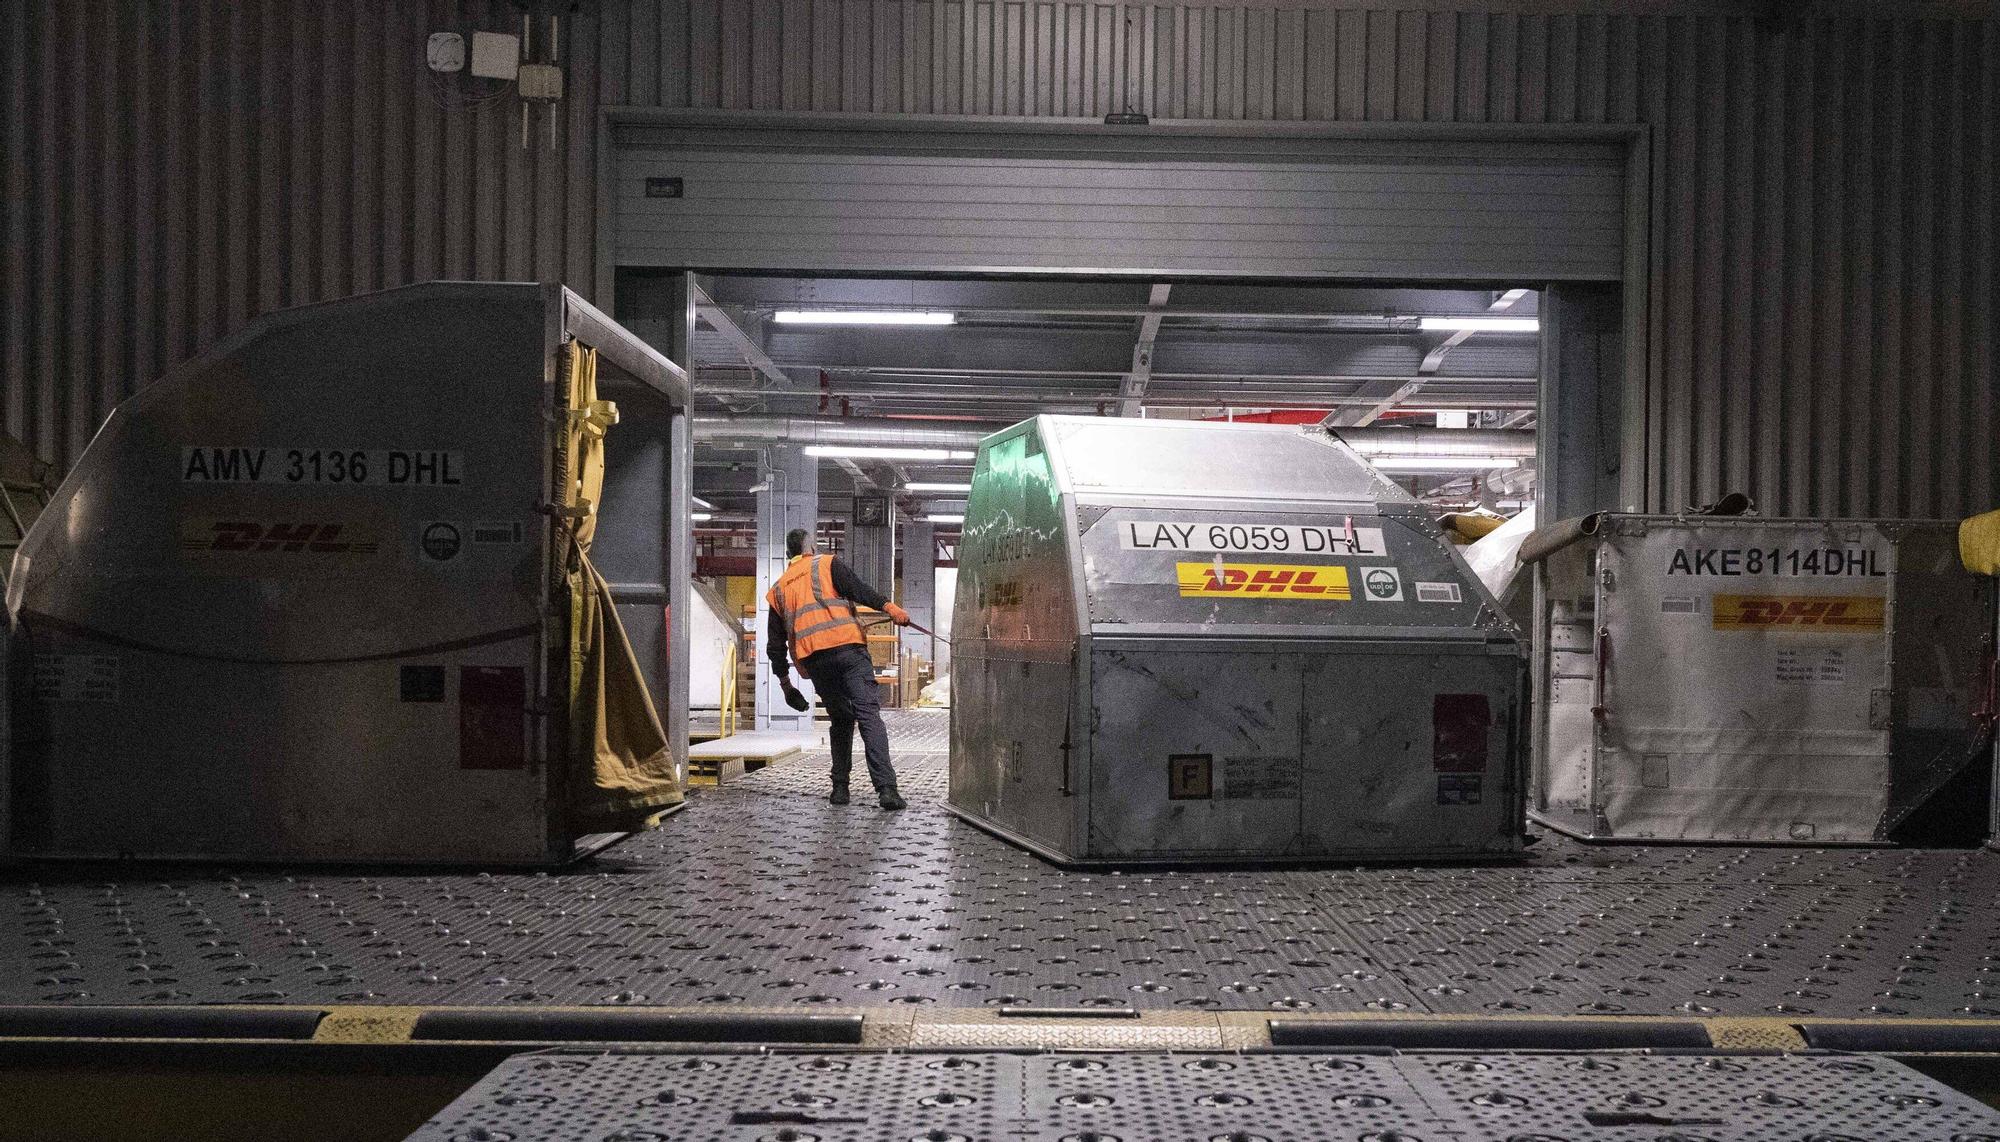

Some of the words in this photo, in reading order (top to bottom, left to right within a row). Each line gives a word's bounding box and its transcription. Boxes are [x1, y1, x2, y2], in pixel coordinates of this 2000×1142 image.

[184, 448, 266, 481] AMV
[287, 450, 367, 483] 3136
[388, 451, 461, 485] DHL
[211, 522, 351, 553] DHL
[1130, 522, 1196, 549] LAY
[1208, 525, 1289, 551] 6059
[1301, 527, 1375, 554] DHL
[1202, 568, 1328, 594] DHL
[1738, 602, 1858, 624] DHL
[1182, 765, 1200, 789] F
